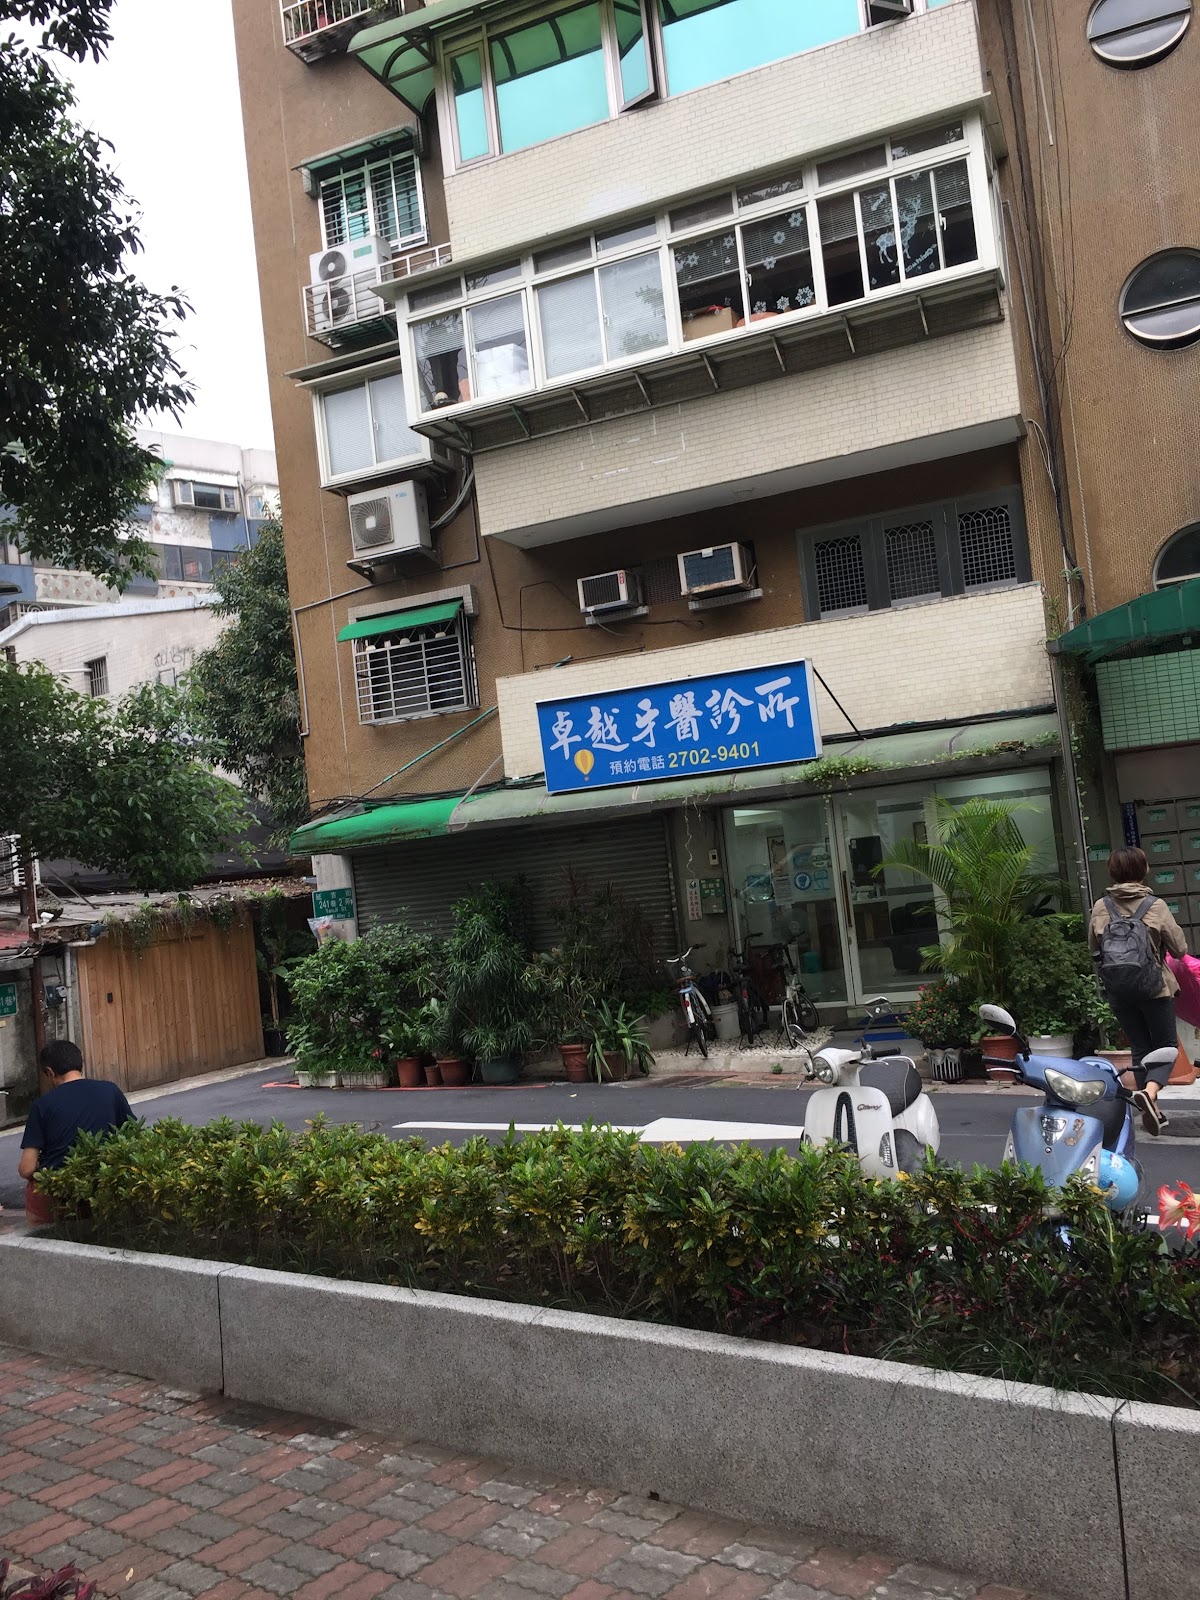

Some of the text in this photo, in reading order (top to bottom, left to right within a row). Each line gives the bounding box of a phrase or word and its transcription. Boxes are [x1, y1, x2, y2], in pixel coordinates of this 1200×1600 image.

[550, 676, 800, 760] 卓越牙醫診所
[609, 741, 760, 775] 預約電話 2702-9401
